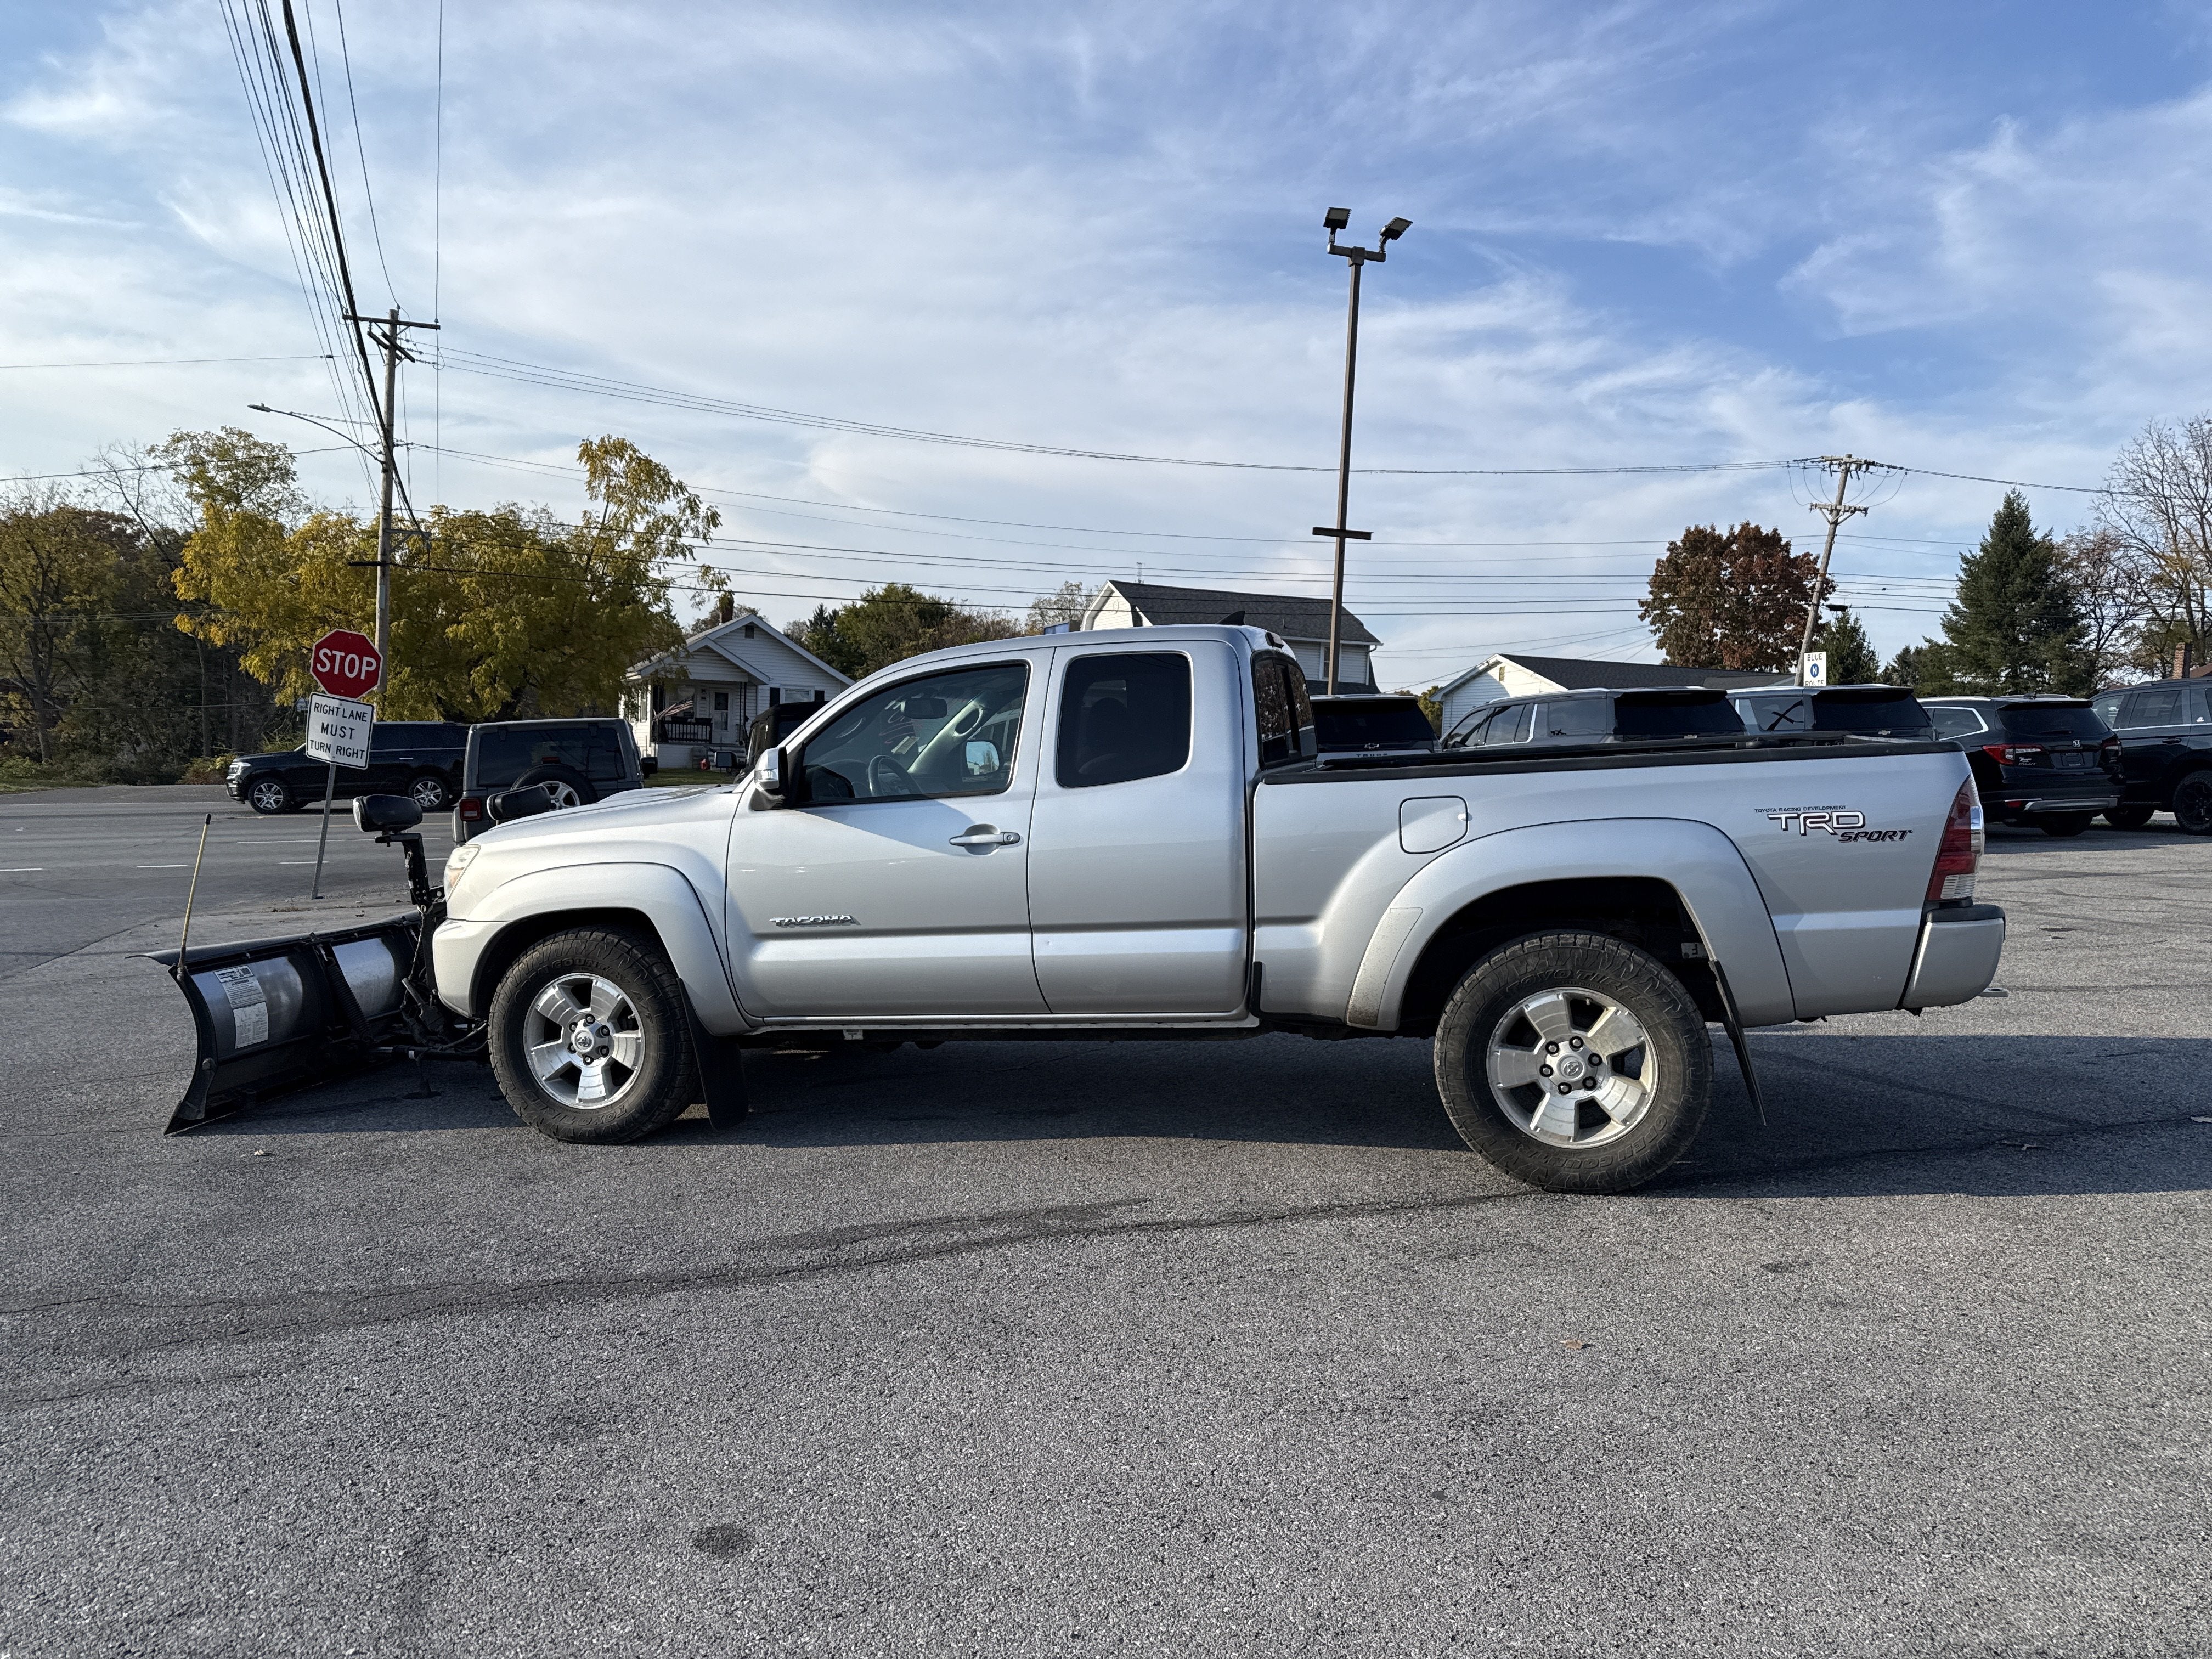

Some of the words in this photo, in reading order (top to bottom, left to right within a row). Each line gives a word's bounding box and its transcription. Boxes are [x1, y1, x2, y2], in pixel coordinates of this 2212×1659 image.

[316, 648, 377, 680] STOP
[1812, 666, 1818, 675] N
[313, 702, 341, 716] RIGHT
[342, 708, 368, 722] LANE
[320, 722, 356, 740] MUST
[309, 740, 331, 754] TURN
[336, 746, 365, 760] RIGHT
[1767, 810, 1865, 837] TRD
[1838, 830, 1914, 843] SPORT
[769, 915, 857, 927] TACOMA
[552, 958, 630, 983] COUNTRY
[1576, 969, 1655, 1010] TIRES
[578, 1105, 627, 1126] TOYO
[1619, 1114, 1668, 1162] OPEN
